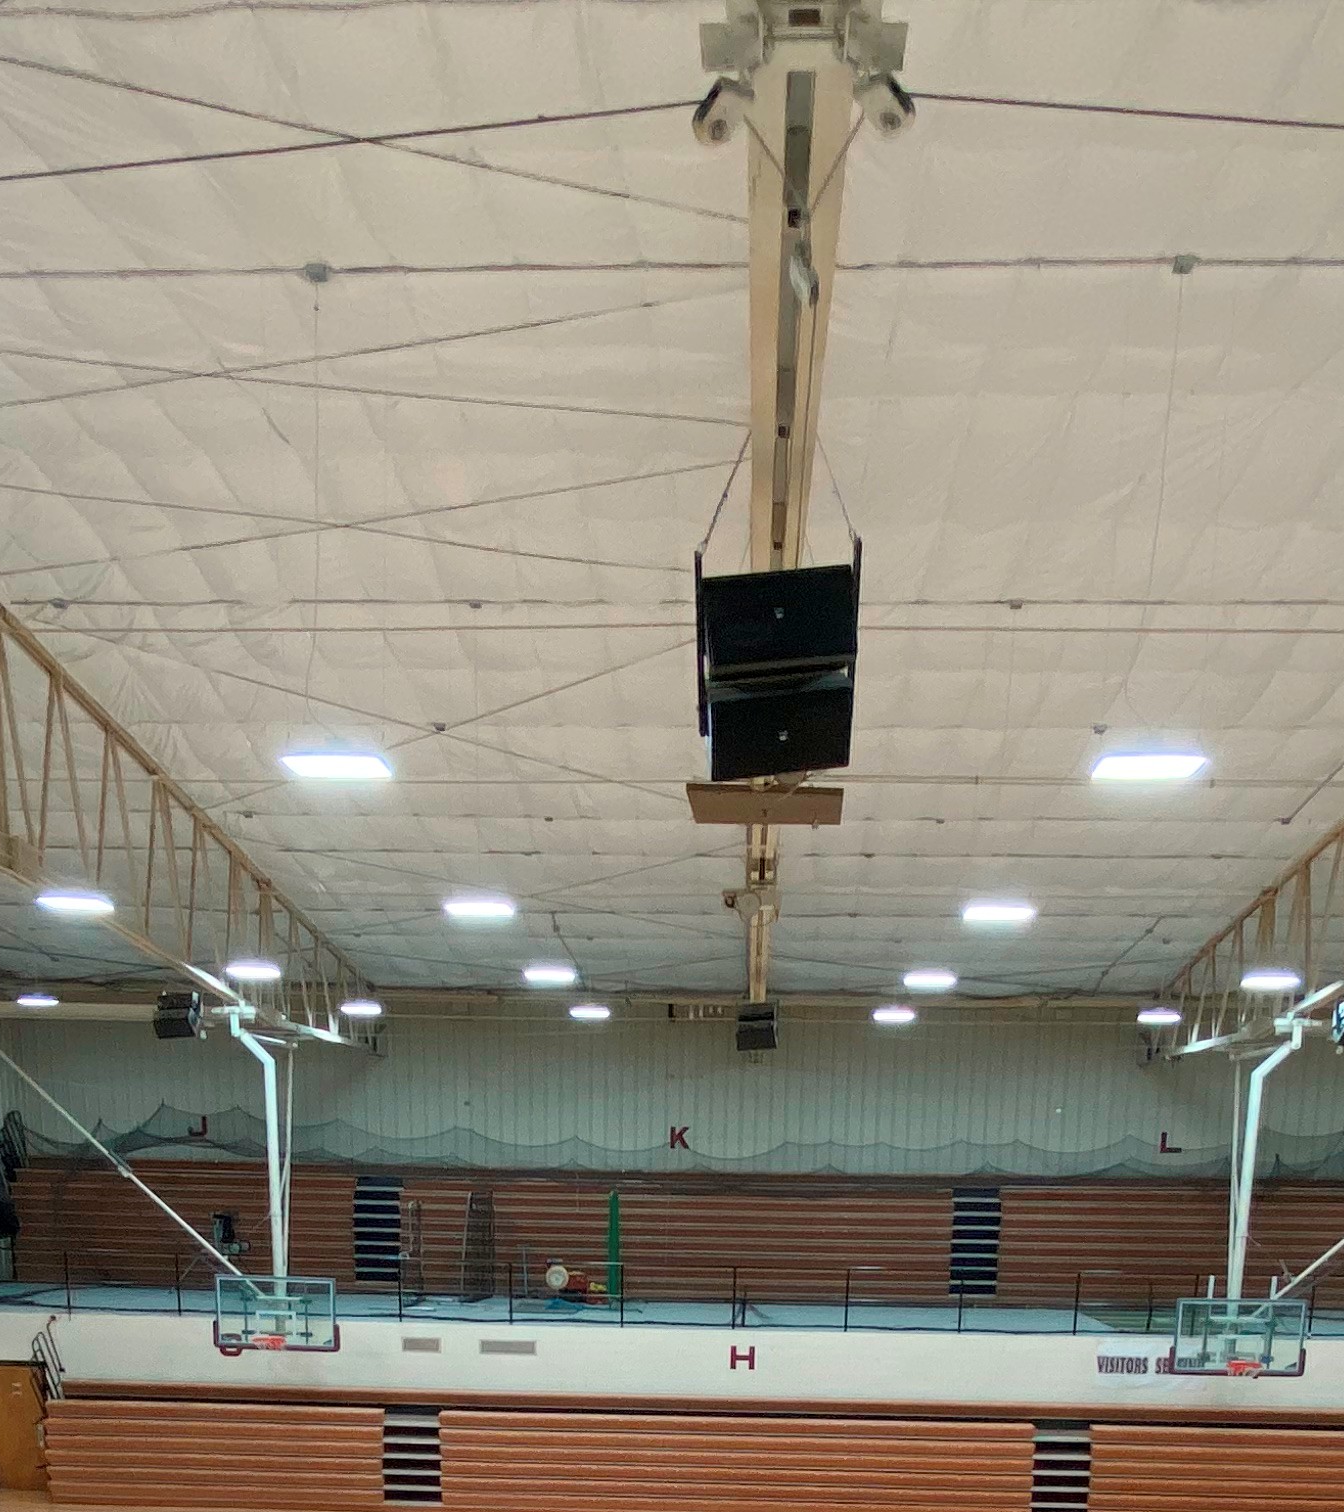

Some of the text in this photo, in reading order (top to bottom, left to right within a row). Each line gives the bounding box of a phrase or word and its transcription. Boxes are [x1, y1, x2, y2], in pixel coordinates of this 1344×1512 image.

[187, 1115, 208, 1137] J
[669, 1126, 690, 1149] K
[1160, 1131, 1182, 1153] L
[730, 1345, 755, 1370] H
[1096, 1355, 1149, 1375] VISITORS
